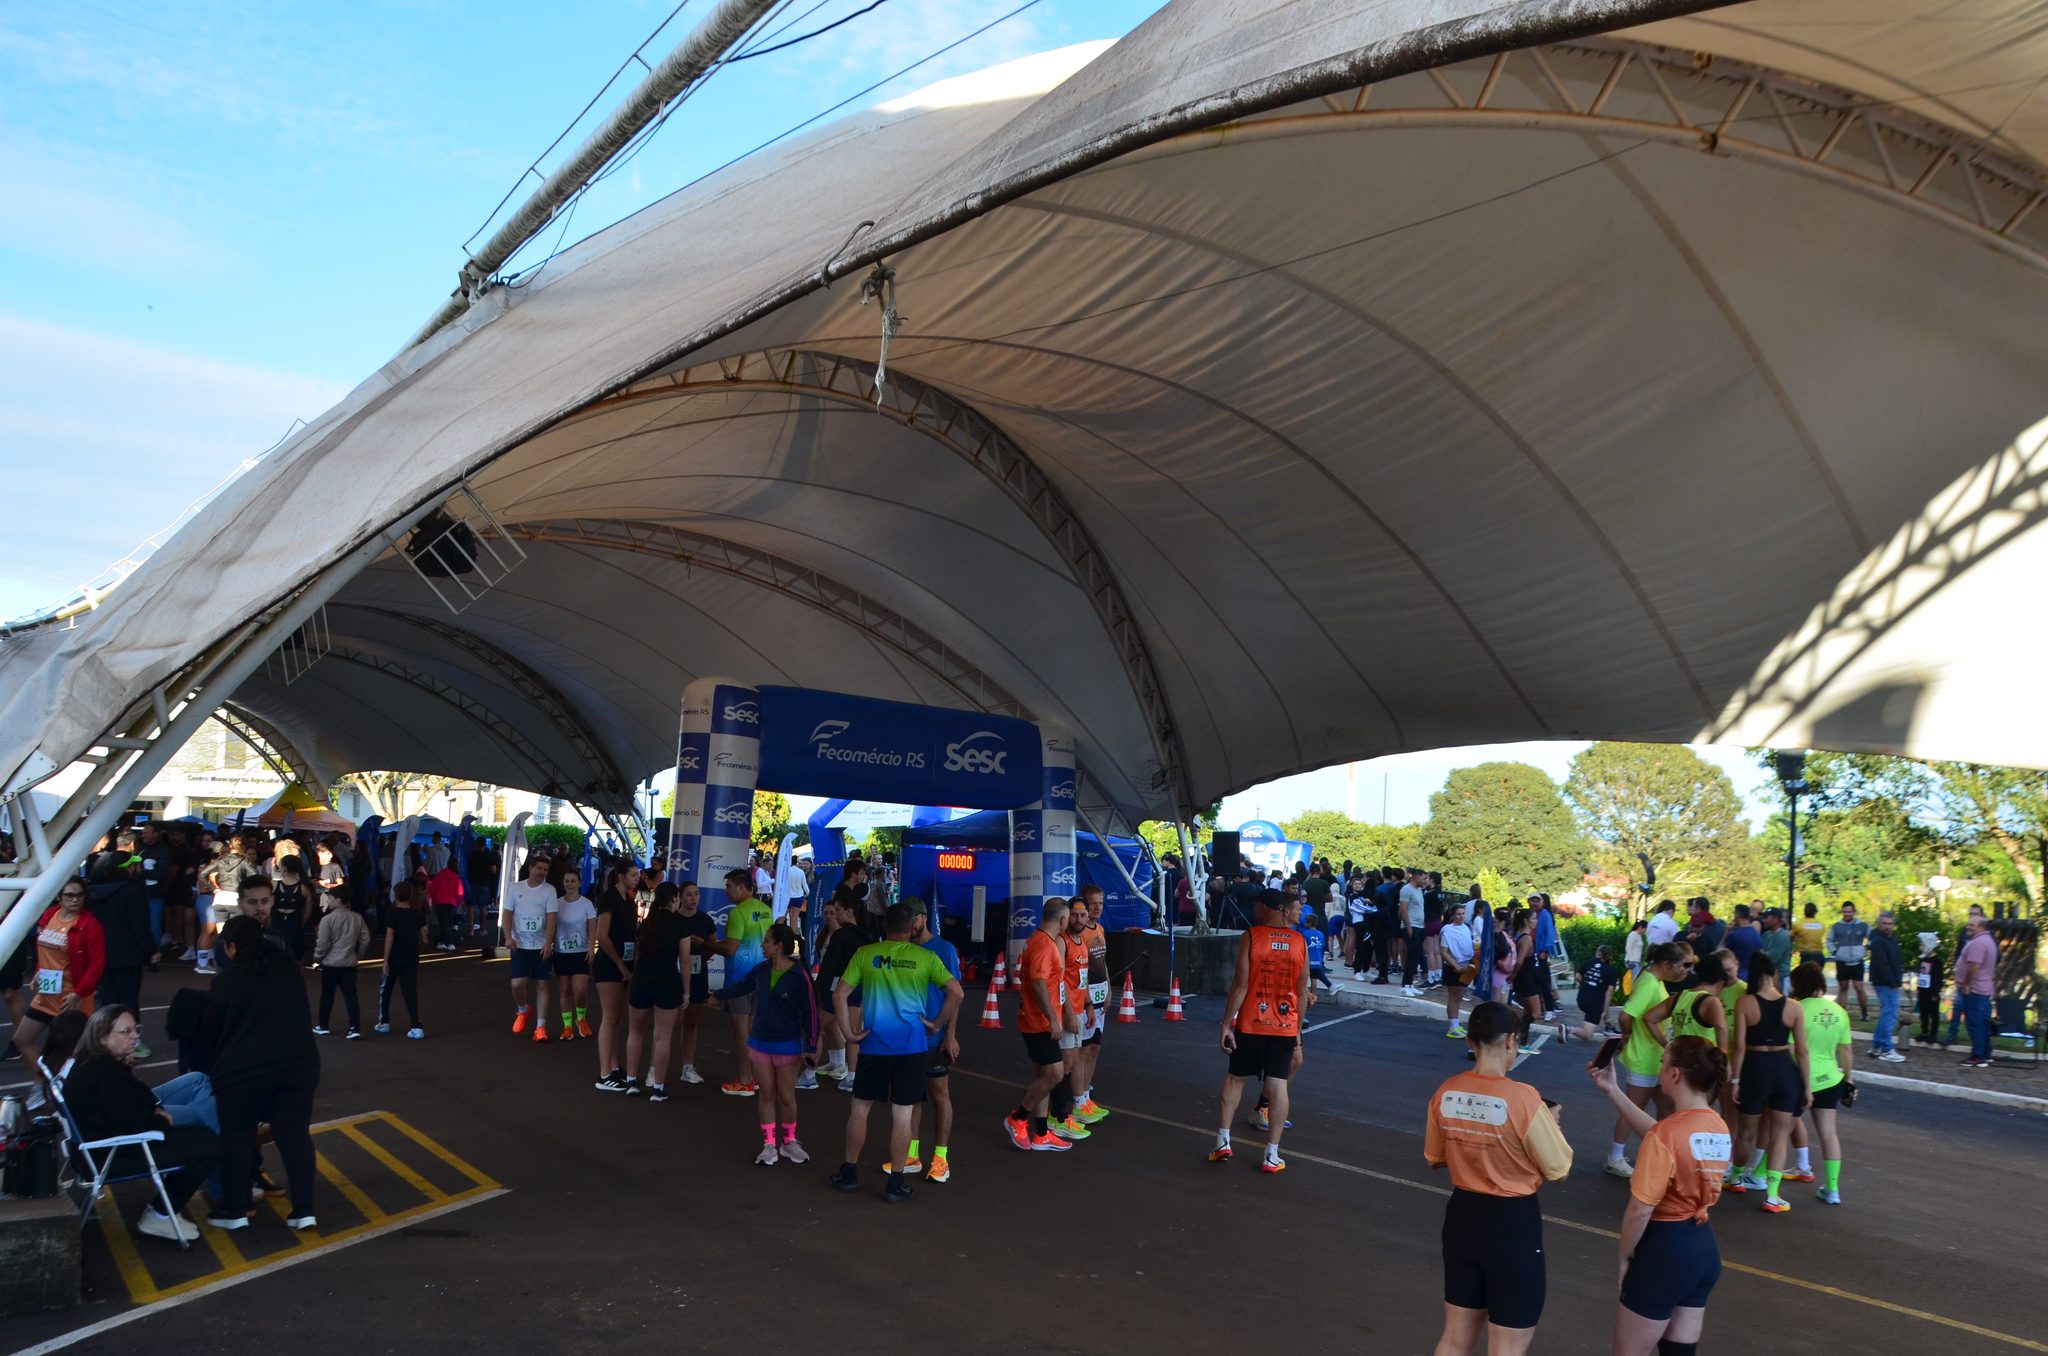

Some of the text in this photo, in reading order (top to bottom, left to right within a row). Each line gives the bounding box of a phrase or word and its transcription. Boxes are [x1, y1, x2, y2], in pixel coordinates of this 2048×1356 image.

[816, 742, 925, 768] Fecomércio RS
[943, 742, 1008, 775] Sesc
[679, 756, 700, 769] esc
[717, 760, 753, 771] Fecomércio
[1014, 829, 1036, 841] esc
[669, 858, 691, 871] esc
[525, 921, 537, 931] 13
[562, 939, 579, 950] 121
[39, 978, 57, 992] 281
[1094, 990, 1106, 1002] 85
